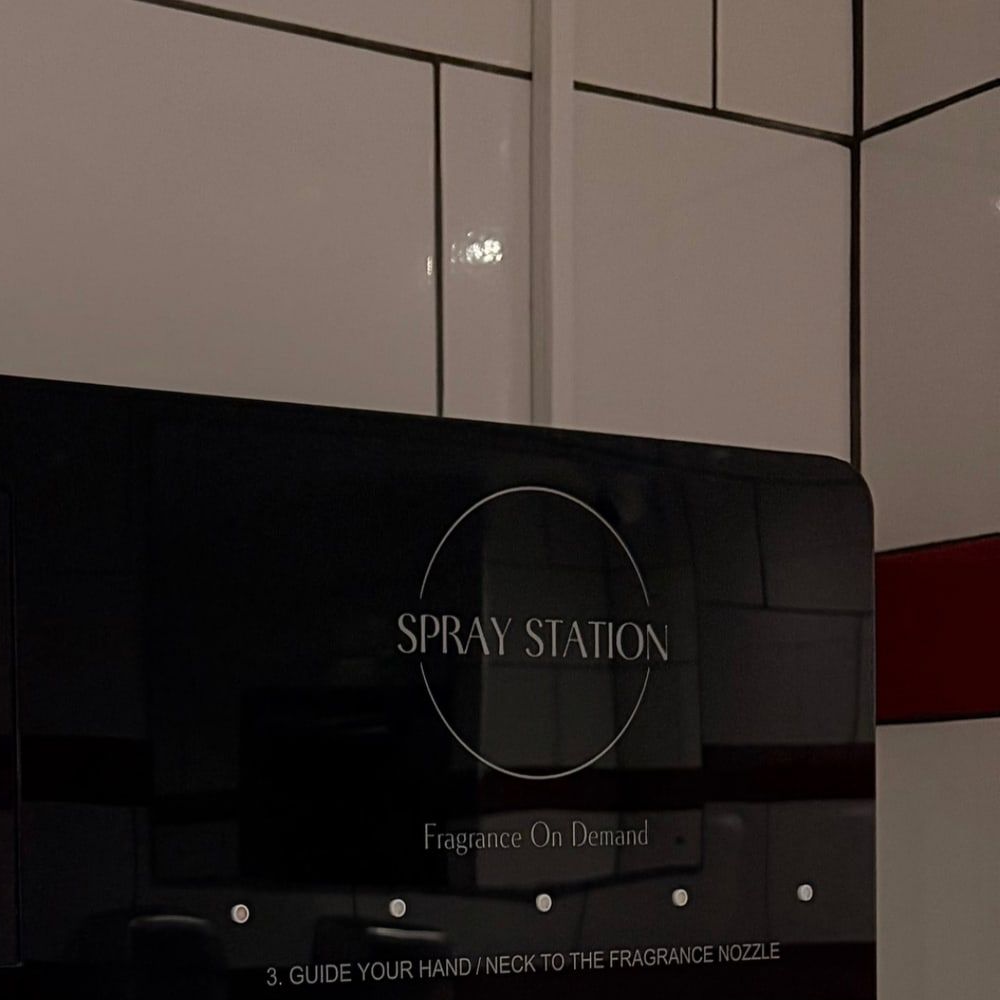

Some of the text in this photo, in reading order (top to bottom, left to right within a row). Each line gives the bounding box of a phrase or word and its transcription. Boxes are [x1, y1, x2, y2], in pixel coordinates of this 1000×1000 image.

[397, 613, 668, 661] SPRAY STATION
[424, 819, 649, 856] Fragrance On Demand
[266, 967, 282, 986] 3.
[289, 963, 352, 985] GUIDE
[358, 960, 413, 981] YOUR
[419, 957, 471, 978] HAND
[486, 954, 536, 974] NECK
[540, 952, 565, 972] TO
[569, 951, 604, 970] THE
[610, 945, 714, 968] FRAGRANCE
[718, 942, 780, 962] NOZZLE
